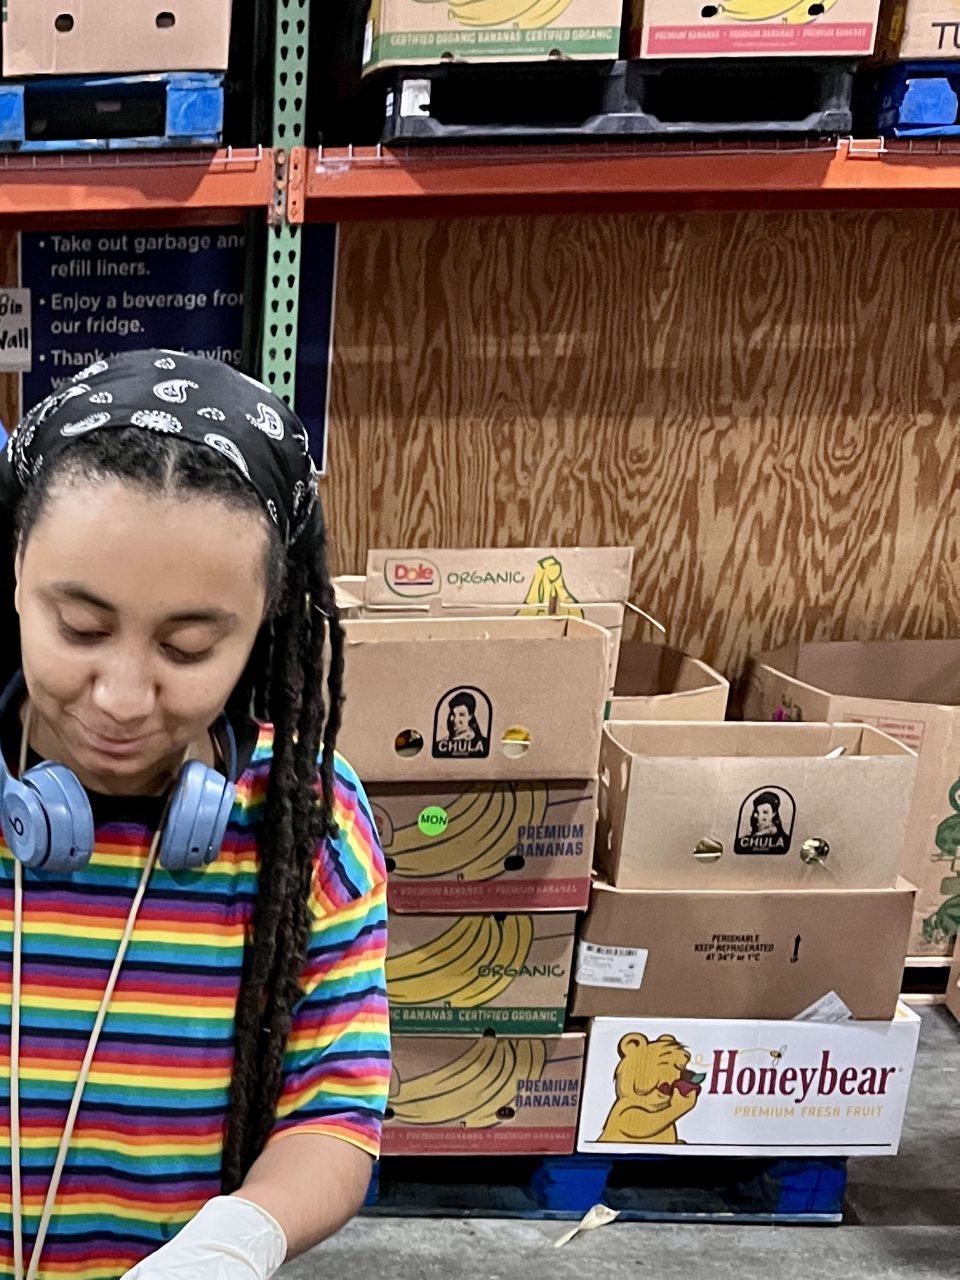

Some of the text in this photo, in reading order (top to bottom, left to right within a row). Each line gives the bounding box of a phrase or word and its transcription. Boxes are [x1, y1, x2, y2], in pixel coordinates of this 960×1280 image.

[436, 32, 476, 45] ORGANIC
[51, 233, 211, 254] Take out garbage
[51, 257, 151, 277] refill liners.
[51, 290, 207, 313] Enjoy a beverage
[51, 314, 145, 336] our fridge.
[394, 563, 434, 581] Dole
[446, 570, 525, 585] ORGANIC
[438, 740, 484, 752] CHULA
[420, 814, 447, 825] MON
[517, 823, 585, 840] PREMIUM
[740, 836, 785, 848] CHULA
[515, 842, 583, 858] BANANAS
[712, 934, 760, 943] PERISHABLE
[694, 943, 775, 953] KEEP REFRIGERATED
[478, 964, 565, 978] ORGANIC
[403, 1010, 558, 1022] BANANAS CERTIFIED ORGANIC
[707, 1049, 896, 1104] Honeybear
[517, 1079, 579, 1093] PREMIUM
[515, 1094, 578, 1108] BANANAS
[734, 1105, 884, 1118] PREMIUM FRESH FRUIT
